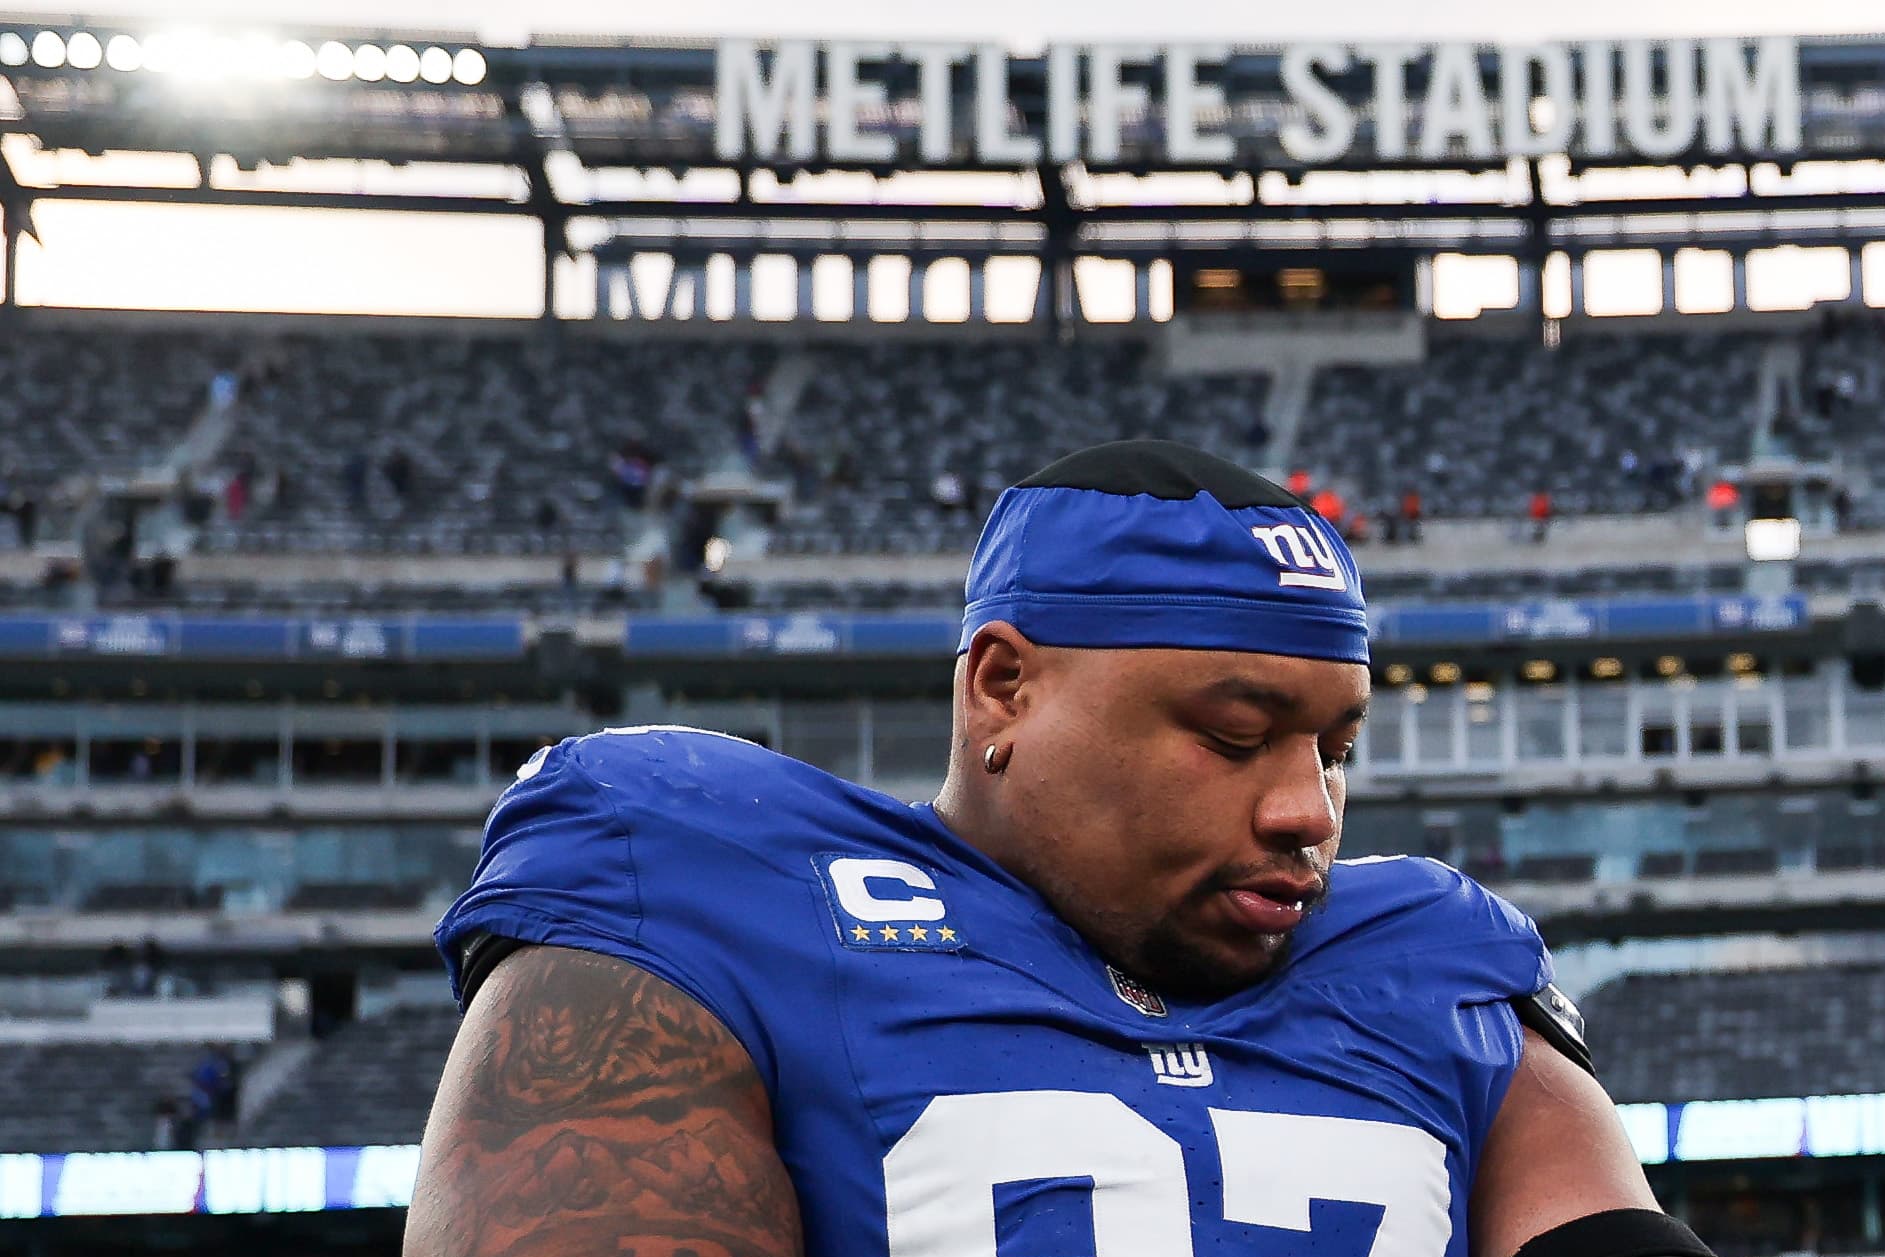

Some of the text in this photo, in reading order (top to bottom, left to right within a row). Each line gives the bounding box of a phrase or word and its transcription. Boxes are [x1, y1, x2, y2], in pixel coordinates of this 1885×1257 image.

[715, 37, 1797, 163] METLIFE STADIUM
[1251, 524, 1347, 592] ny
[829, 858, 946, 922] C
[1142, 1042, 1214, 1087] ny
